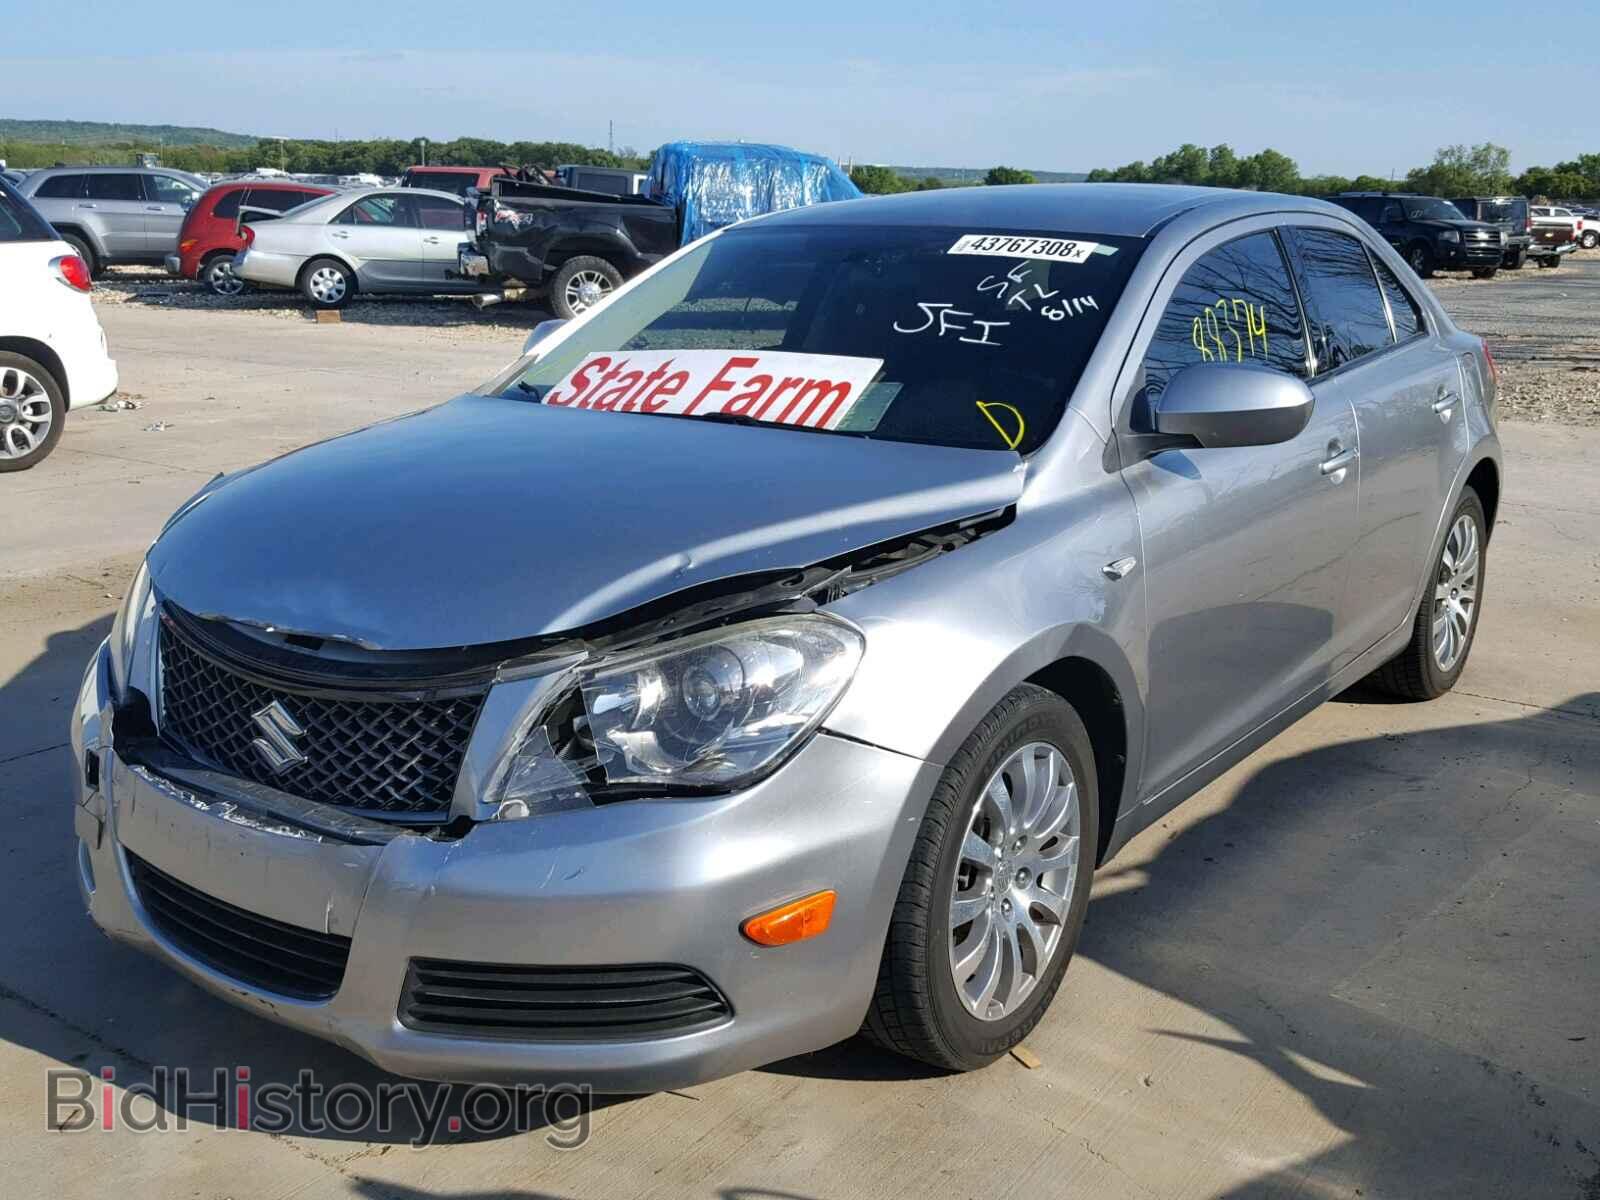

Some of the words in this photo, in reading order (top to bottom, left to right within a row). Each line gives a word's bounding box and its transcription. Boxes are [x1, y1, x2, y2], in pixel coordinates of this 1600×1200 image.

[1041, 295, 1100, 321] 8/14
[547, 355, 691, 415] State
[684, 356, 853, 431] Farm
